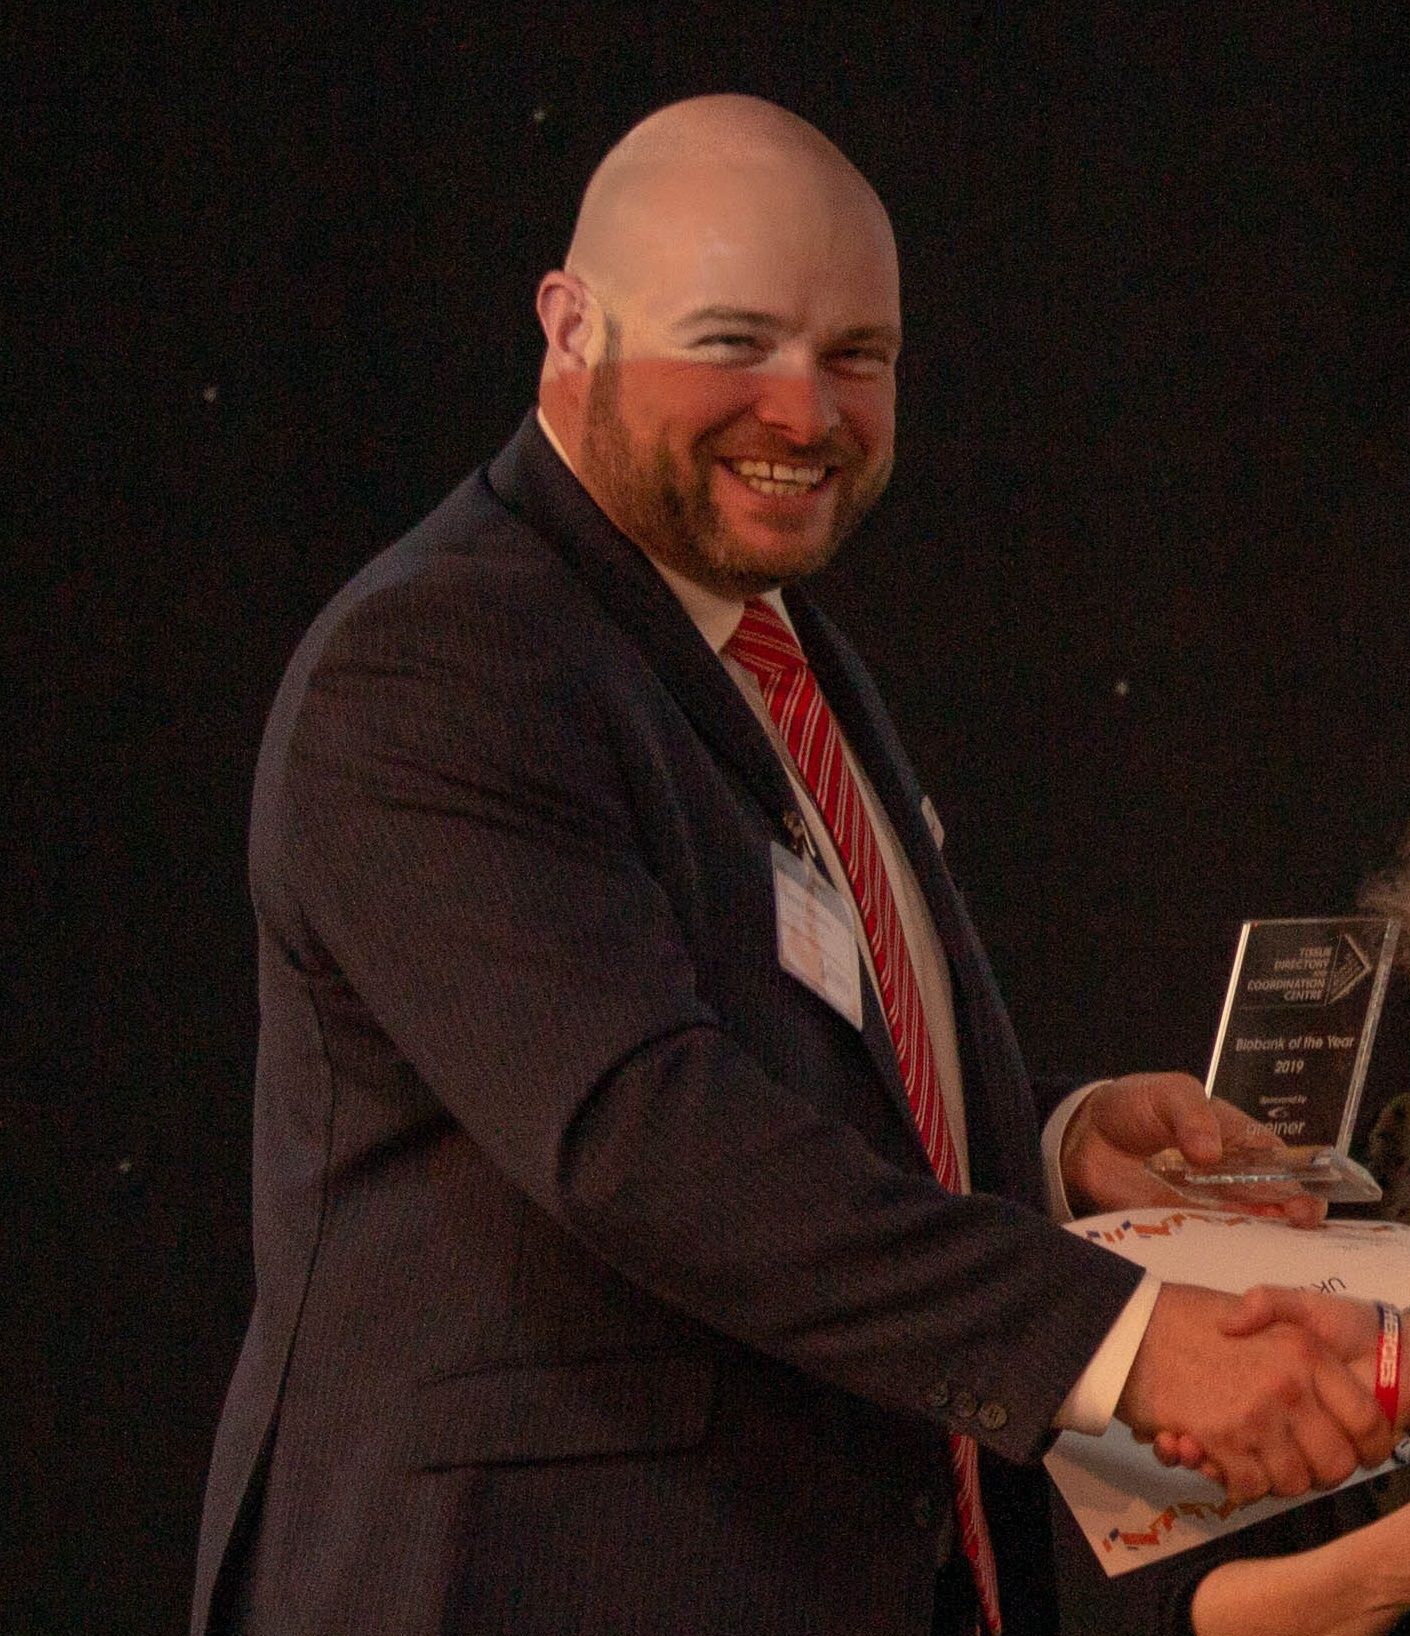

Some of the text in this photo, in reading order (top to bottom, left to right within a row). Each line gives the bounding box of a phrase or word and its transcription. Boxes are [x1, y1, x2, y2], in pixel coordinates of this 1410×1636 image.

[1247, 977, 1325, 993] COORDINATION
[1236, 1035, 1355, 1053] Biobank of the Year
[1275, 1060, 1306, 1075] 2019
[1310, 1277, 1346, 1295] UK
